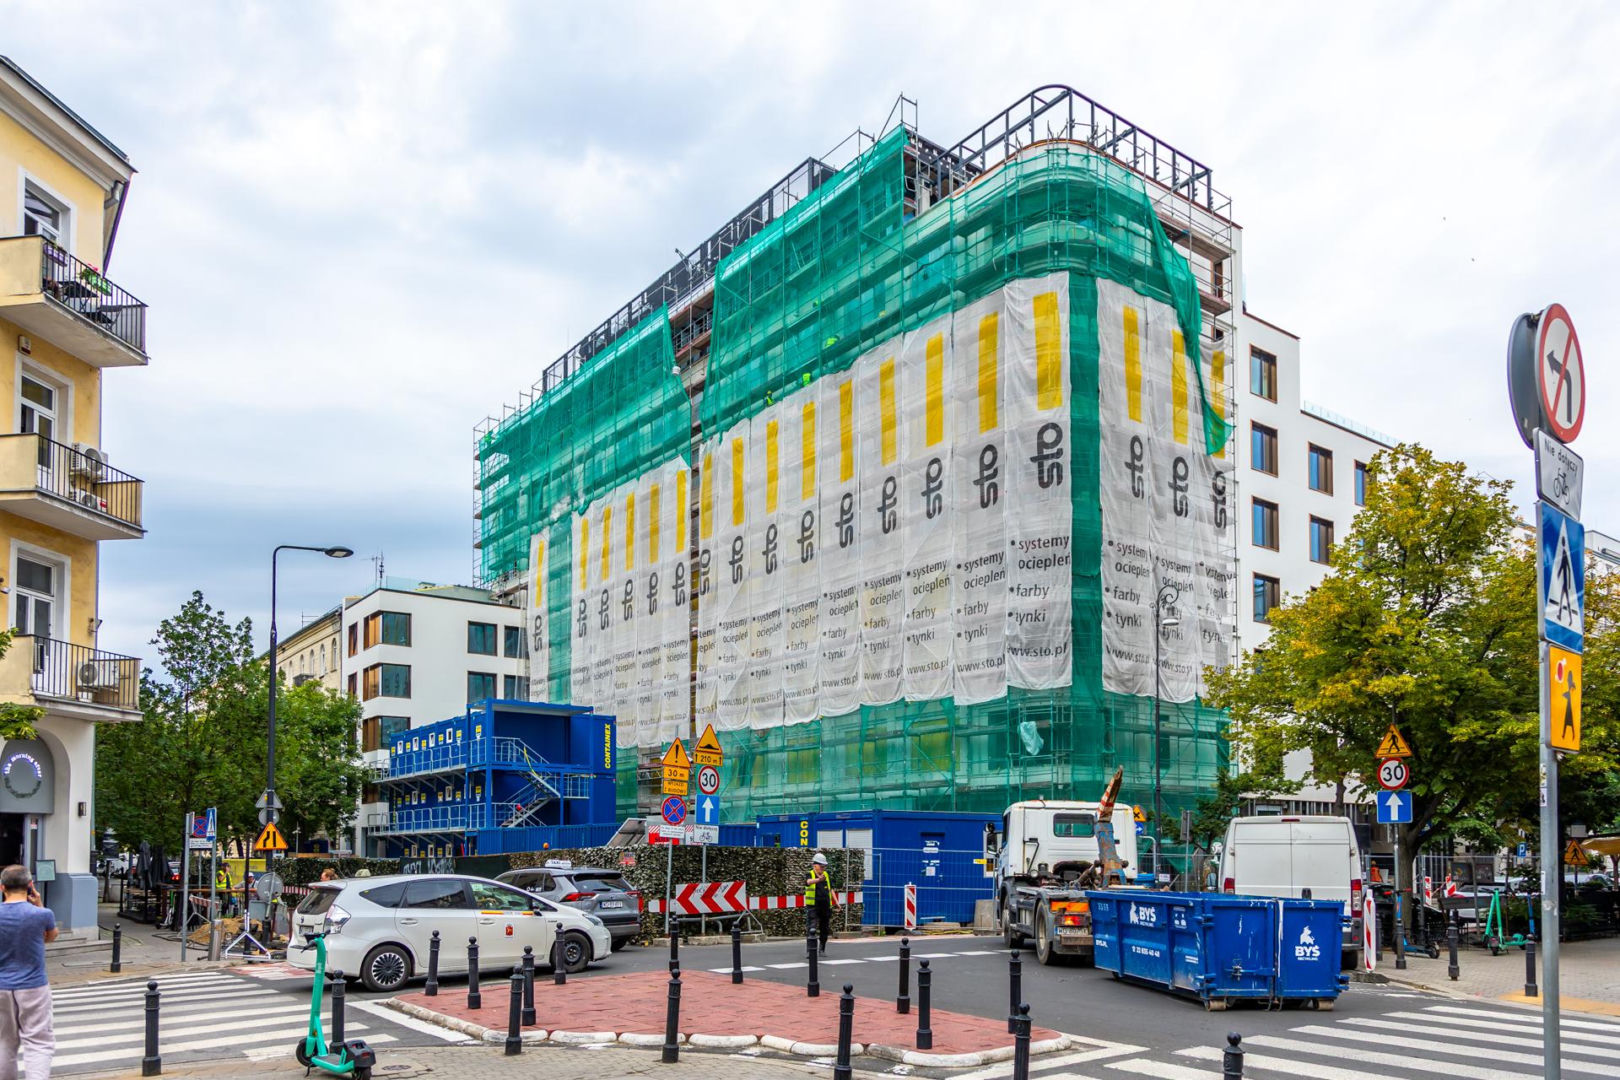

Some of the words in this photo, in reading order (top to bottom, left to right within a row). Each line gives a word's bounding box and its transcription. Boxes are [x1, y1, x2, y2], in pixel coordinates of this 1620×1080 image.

[1029, 422, 1064, 489] sto
[1544, 438, 1555, 457] Nie
[1558, 448, 1578, 479] dotyczy
[1124, 434, 1144, 500] sto
[972, 444, 998, 509] sto
[920, 456, 943, 520] sto
[1167, 456, 1189, 518] sto
[876, 475, 898, 534] sto
[834, 492, 854, 548] sto
[796, 510, 814, 564] sto
[1018, 536, 1070, 554] systemy
[762, 523, 778, 575] sto
[728, 536, 744, 584] sto
[912, 559, 948, 578] systemy
[964, 551, 1005, 572] systemy
[1161, 558, 1192, 575] systemy
[672, 562, 685, 607] sto
[869, 573, 902, 590] systemy
[912, 575, 950, 596] ociepleń
[963, 567, 1006, 590] ociepleń
[621, 579, 633, 621] sto
[646, 572, 658, 616] sto
[1015, 584, 1050, 599] farby
[1113, 586, 1142, 604] farby
[598, 589, 610, 630] sto
[756, 607, 782, 624] systemy
[791, 599, 818, 615] systemy
[912, 606, 936, 620] farby
[964, 601, 989, 617] farby
[577, 598, 586, 638] sto
[722, 618, 748, 630] systemy
[869, 617, 890, 630] farby
[1115, 613, 1142, 629] tynki
[532, 615, 542, 652] sto
[828, 627, 847, 640] farby
[911, 628, 936, 646] tynki
[964, 624, 989, 643] tynki
[790, 640, 808, 651] farby
[869, 640, 890, 654] tynki
[827, 650, 847, 661] tynki
[956, 654, 1006, 673] www.sto.pl
[754, 668, 771, 680] tynki
[790, 660, 808, 672] tynki
[864, 664, 904, 681] www.sto.pl
[906, 657, 950, 675] www.sto.pl
[822, 672, 860, 688] www.sto.pl
[700, 756, 712, 764] 210
[668, 768, 678, 777] 30
[702, 772, 716, 788] 30
[1382, 765, 1404, 782] 30
[800, 820, 808, 846] CON
[1520, 844, 1526, 856] P
[1294, 944, 1320, 957] BYŚ
